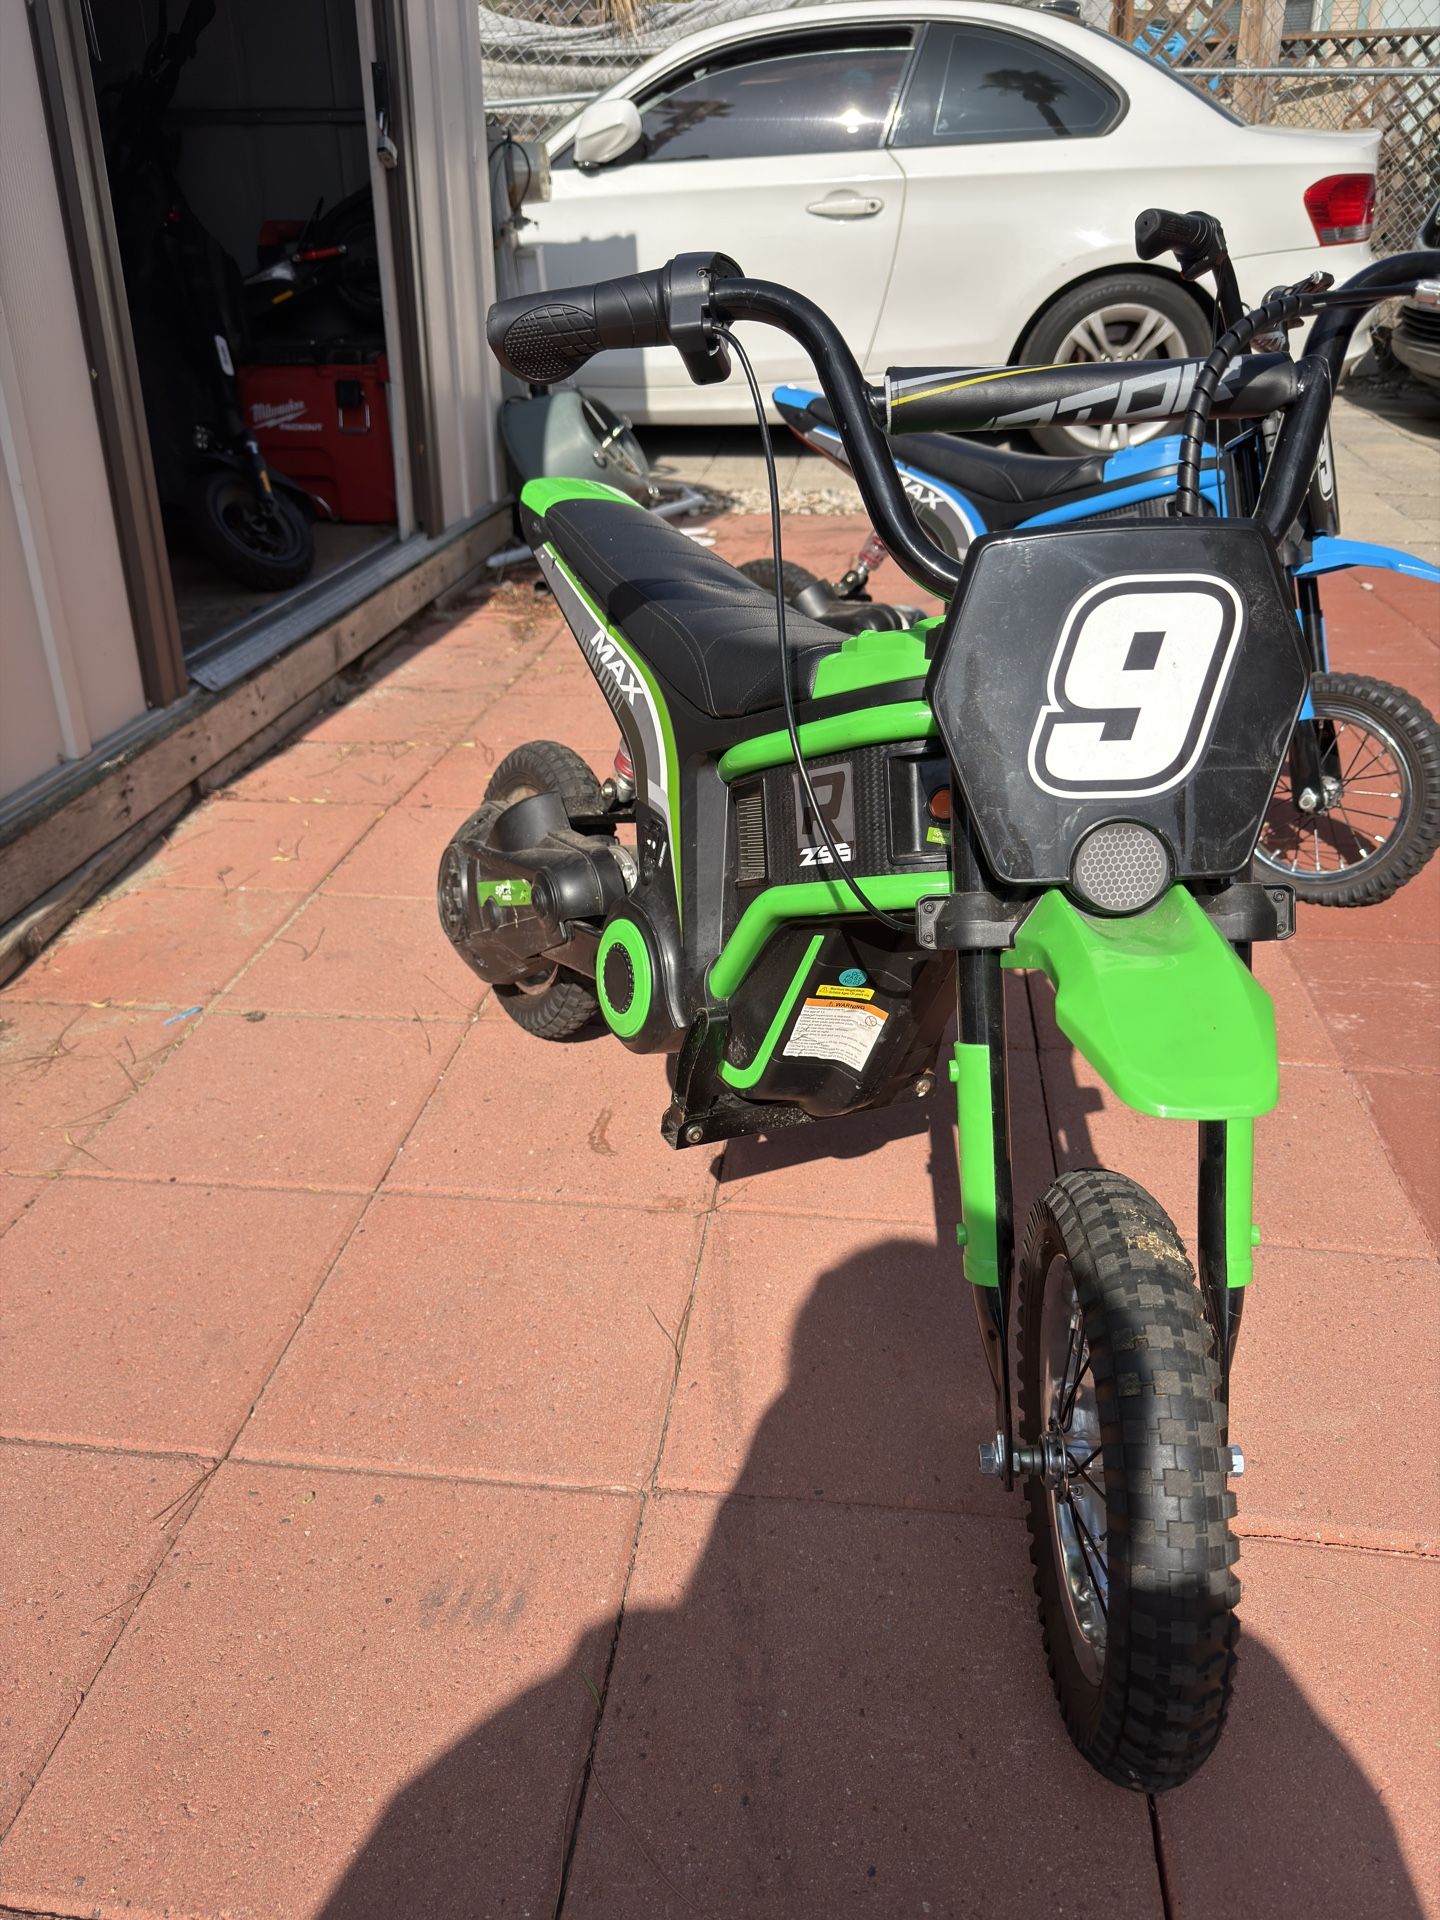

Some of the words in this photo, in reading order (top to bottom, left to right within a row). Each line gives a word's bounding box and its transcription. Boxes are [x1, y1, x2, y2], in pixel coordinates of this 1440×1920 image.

[590, 629, 644, 707] MAX
[1028, 573, 1244, 800] 9
[836, 1002, 865, 1010] WARNING
